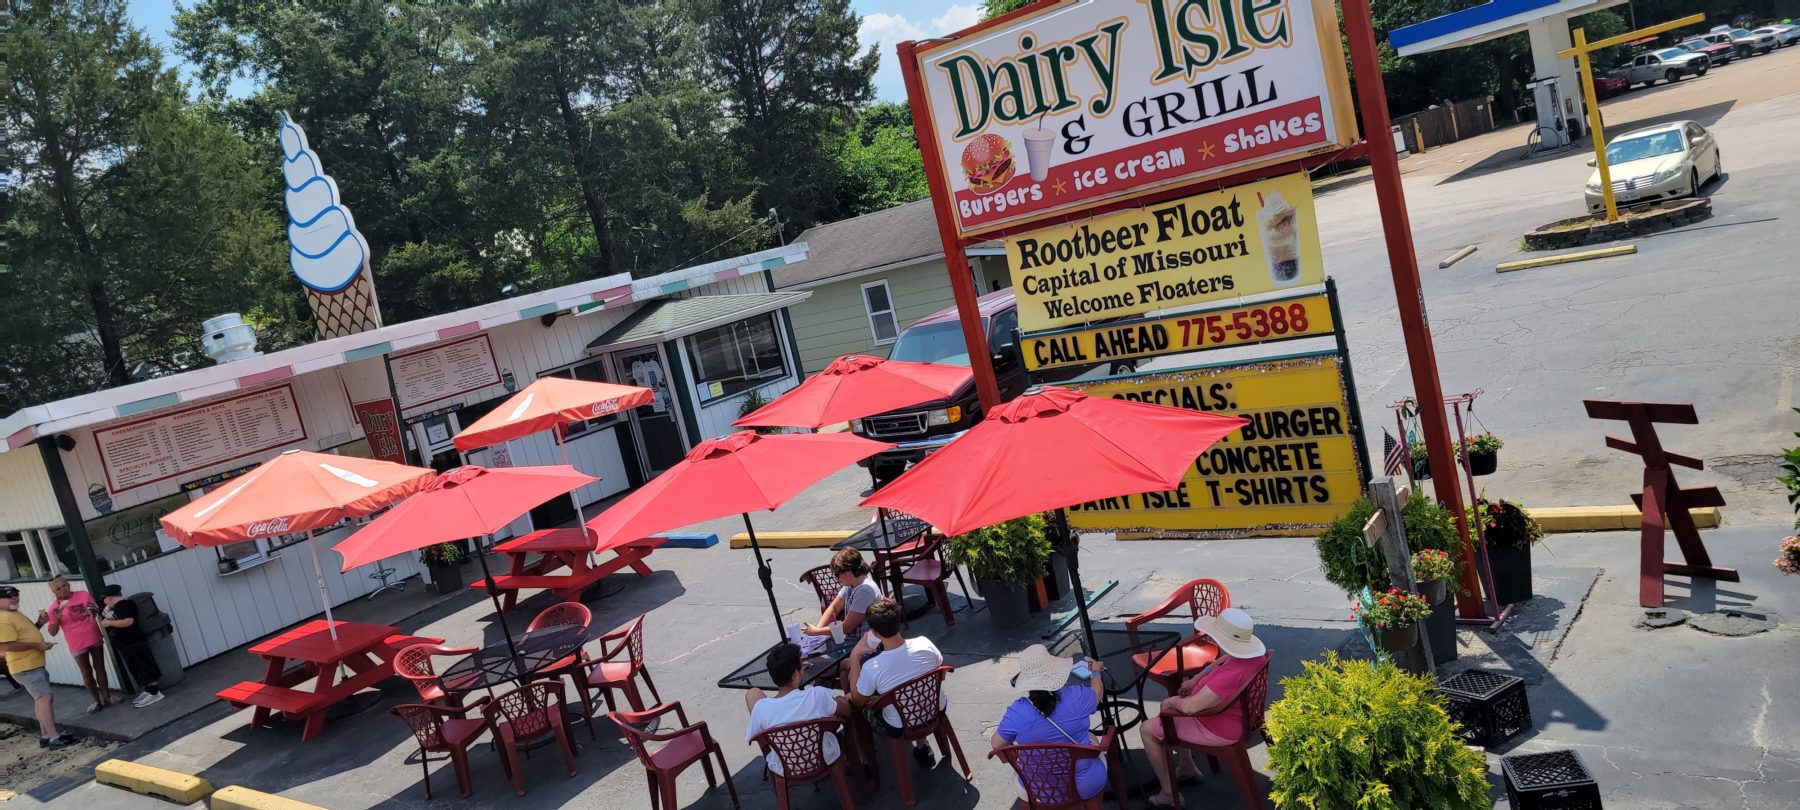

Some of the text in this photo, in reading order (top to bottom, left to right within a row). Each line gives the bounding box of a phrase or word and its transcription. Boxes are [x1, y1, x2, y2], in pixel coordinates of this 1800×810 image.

[936, 0, 1290, 140] Dairy Isle
[1061, 65, 1278, 155] & GRILL
[959, 111, 1322, 219] Burgers ice cream shakes
[1018, 194, 1245, 270] Rootbeer Float
[1022, 234, 1250, 296] Capital of Missouri
[1043, 271, 1235, 320] Welcome Floaters
[1033, 302, 1309, 368] CALL AHEAD 775-5388
[1112, 382, 1237, 412] CIALS:
[361, 409, 394, 434] Dairy
[1238, 407, 1344, 441] BURGER
[374, 432, 398, 457] Isle
[1196, 442, 1322, 476] CONCRETE
[1142, 482, 1191, 509] ISLE
[1206, 475, 1330, 507] T-SHIRTS
[247, 517, 289, 538] Coca-Cola
